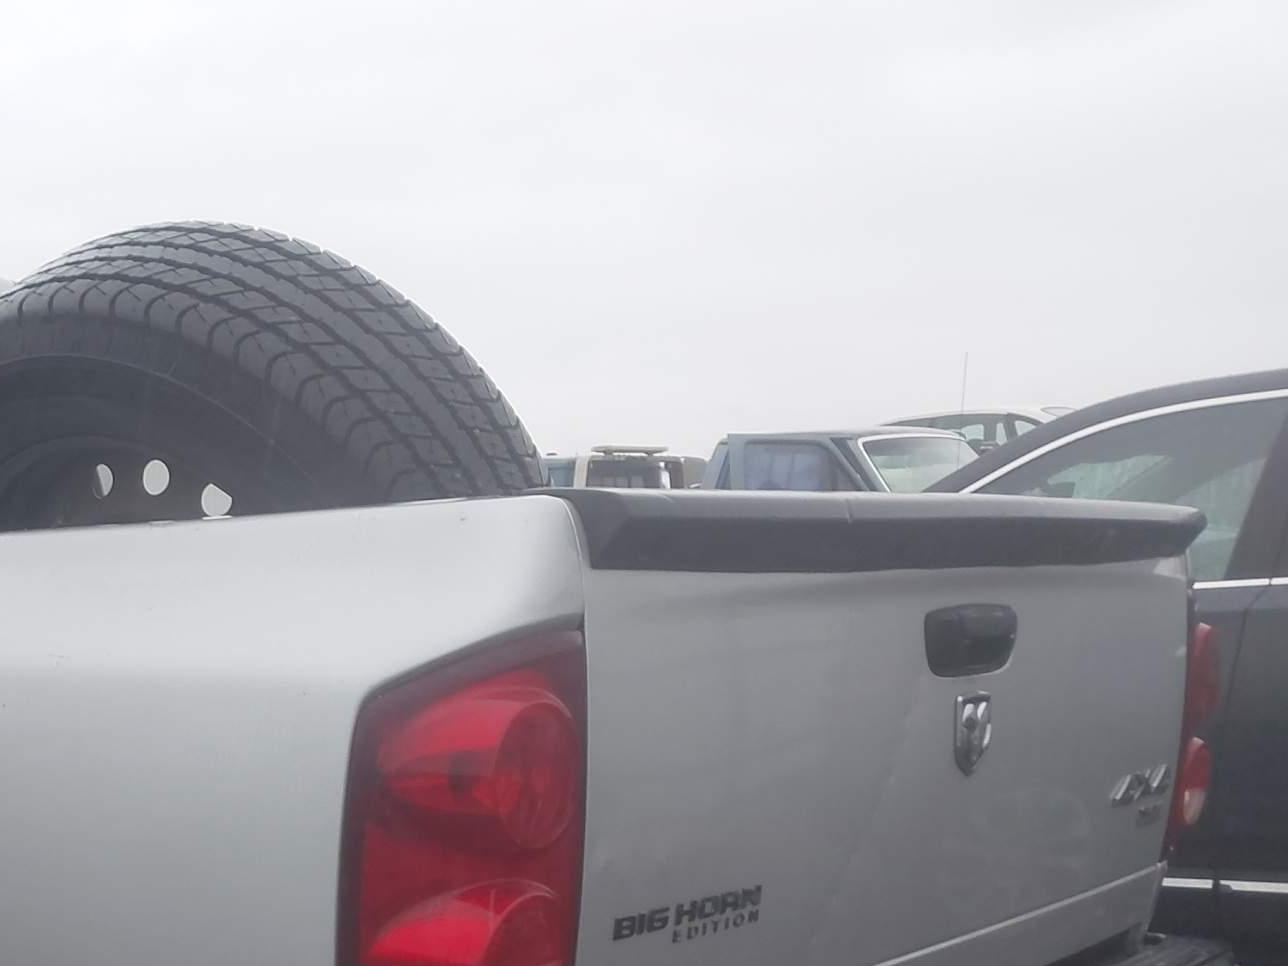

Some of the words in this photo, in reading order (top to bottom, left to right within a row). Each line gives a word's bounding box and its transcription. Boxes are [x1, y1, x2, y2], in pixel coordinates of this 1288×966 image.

[612, 907, 670, 941] BIG
[674, 885, 762, 926] HORN
[672, 909, 760, 943] EDITION
